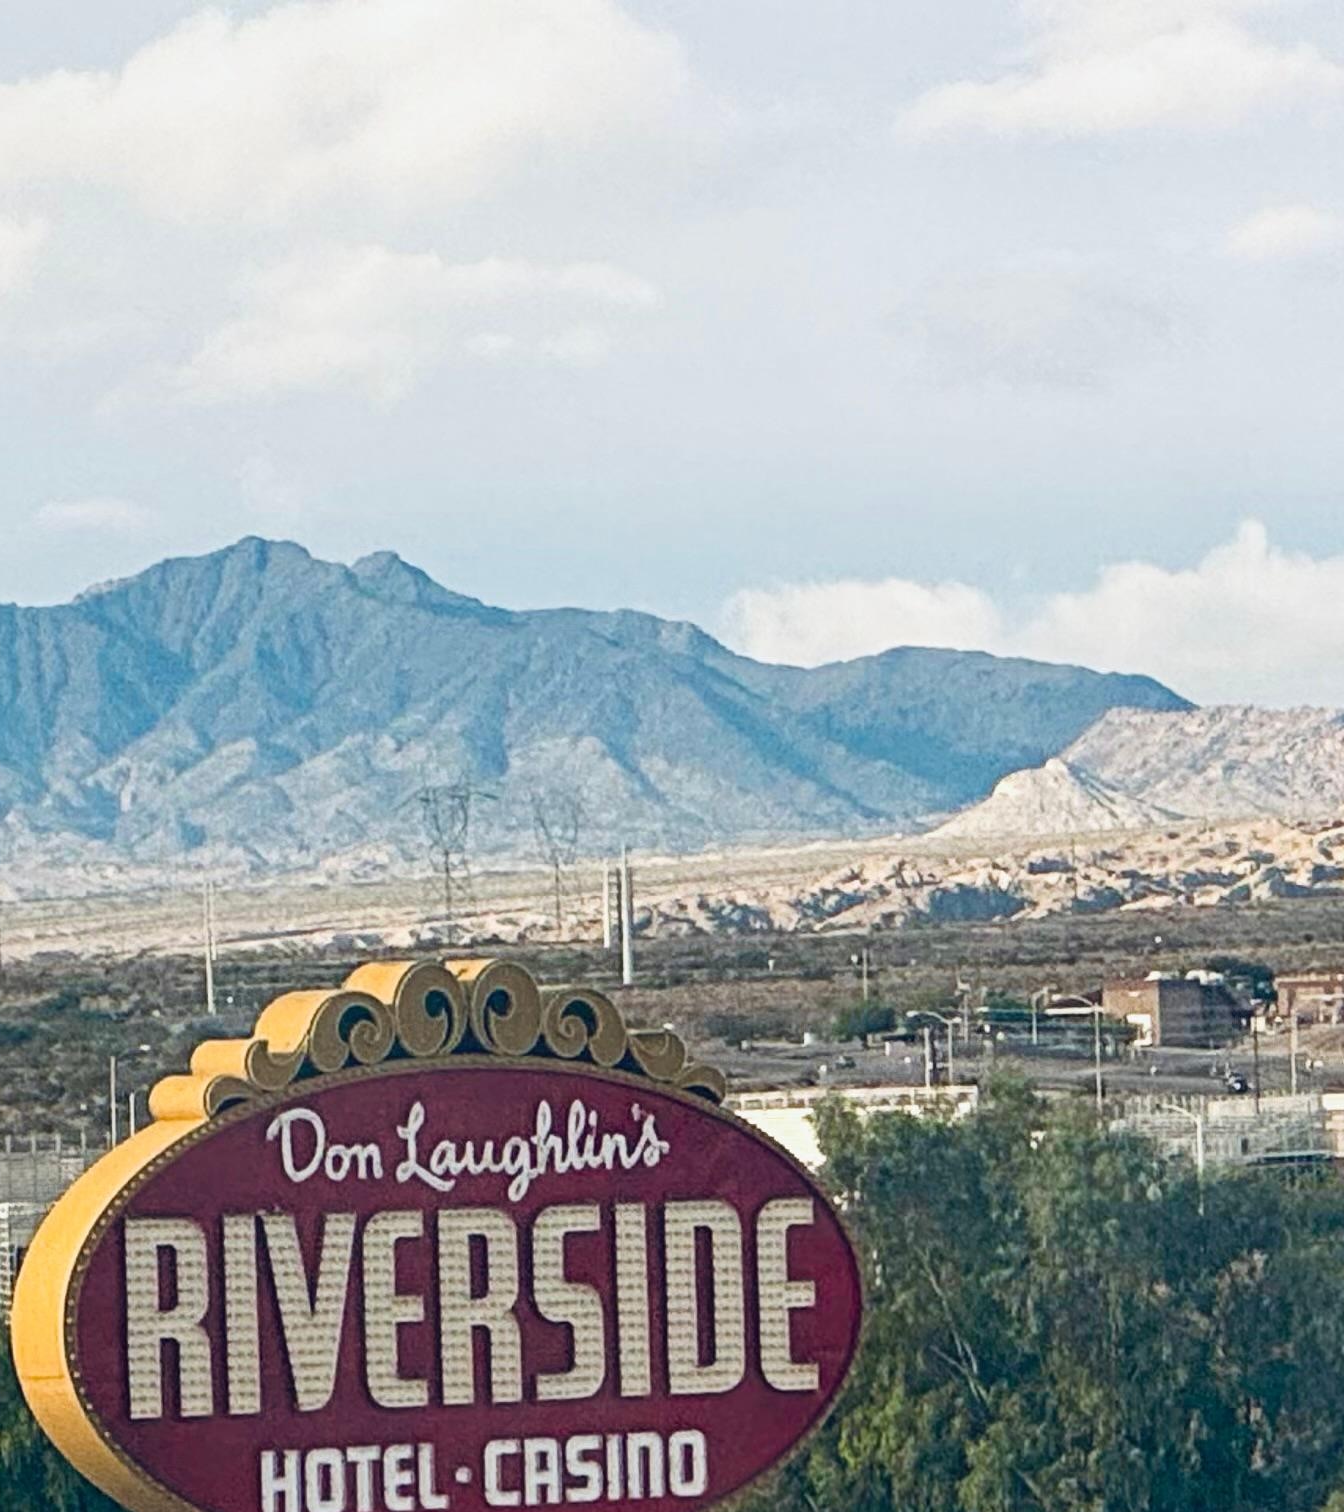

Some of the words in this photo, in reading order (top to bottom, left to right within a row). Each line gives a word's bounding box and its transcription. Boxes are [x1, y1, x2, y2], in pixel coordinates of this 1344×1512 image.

[266, 1107, 384, 1183] Don
[395, 1099, 670, 1202] Laughlin's
[126, 1199, 820, 1420] RIVERSIDE
[484, 1429, 709, 1508] CASINO
